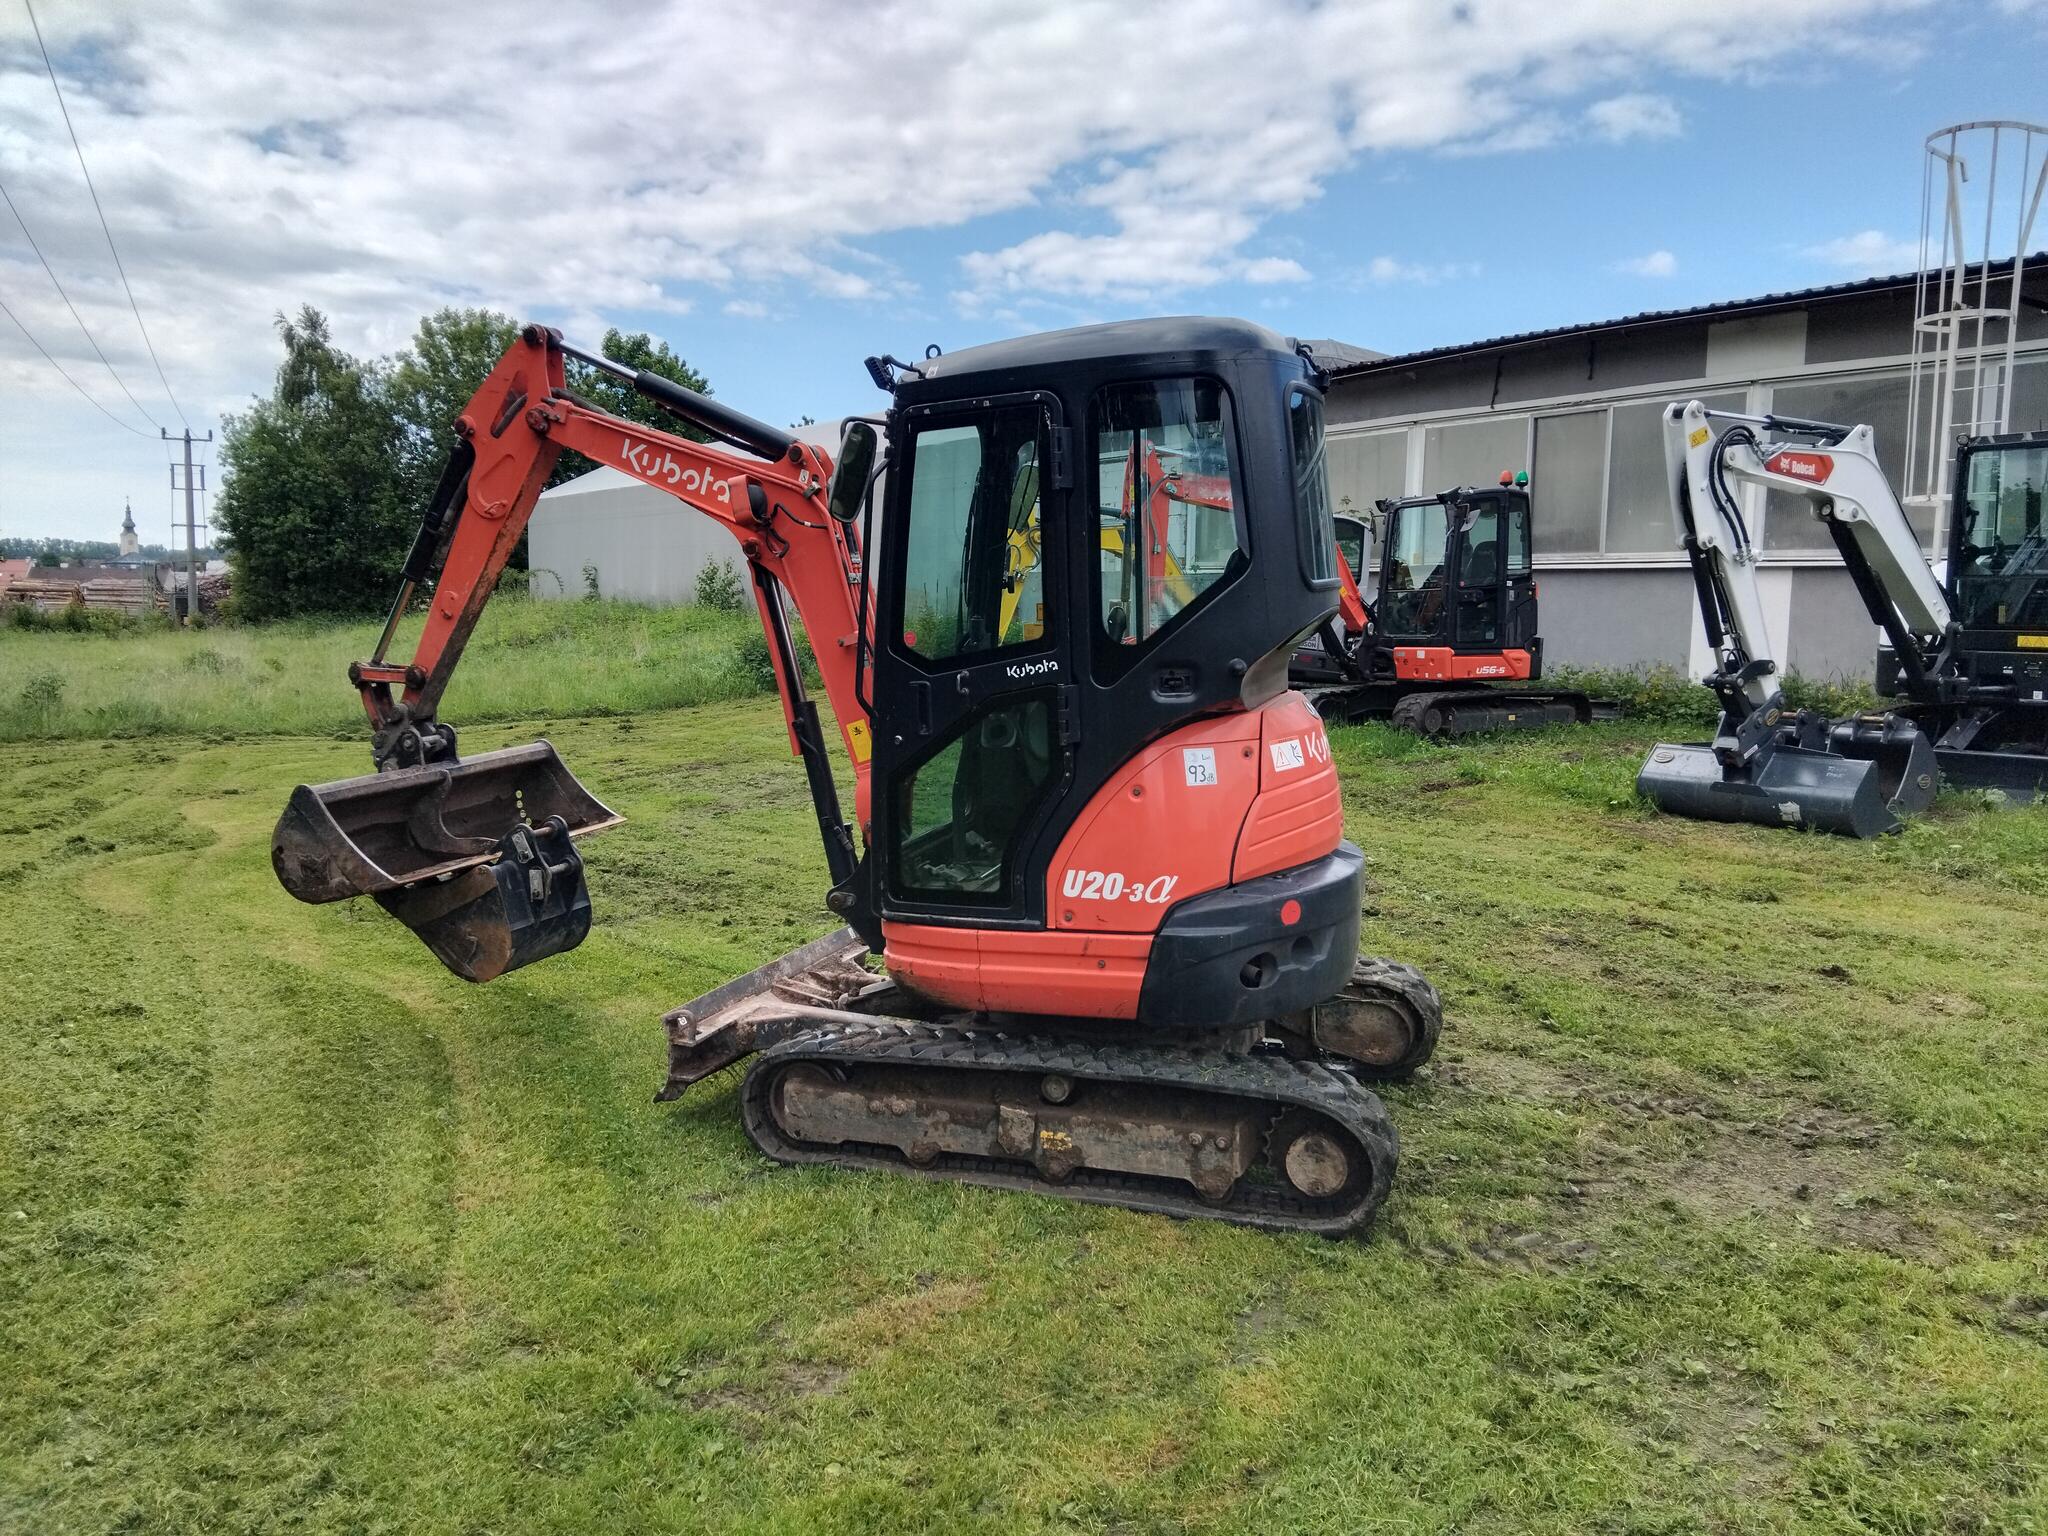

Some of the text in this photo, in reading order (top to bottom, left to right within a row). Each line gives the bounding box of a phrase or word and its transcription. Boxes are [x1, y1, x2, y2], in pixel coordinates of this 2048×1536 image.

[621, 438, 731, 504] Kubota
[1791, 460, 1816, 476] Bobcat
[1006, 659, 1059, 678] Kubota
[1188, 764, 1206, 783] 93
